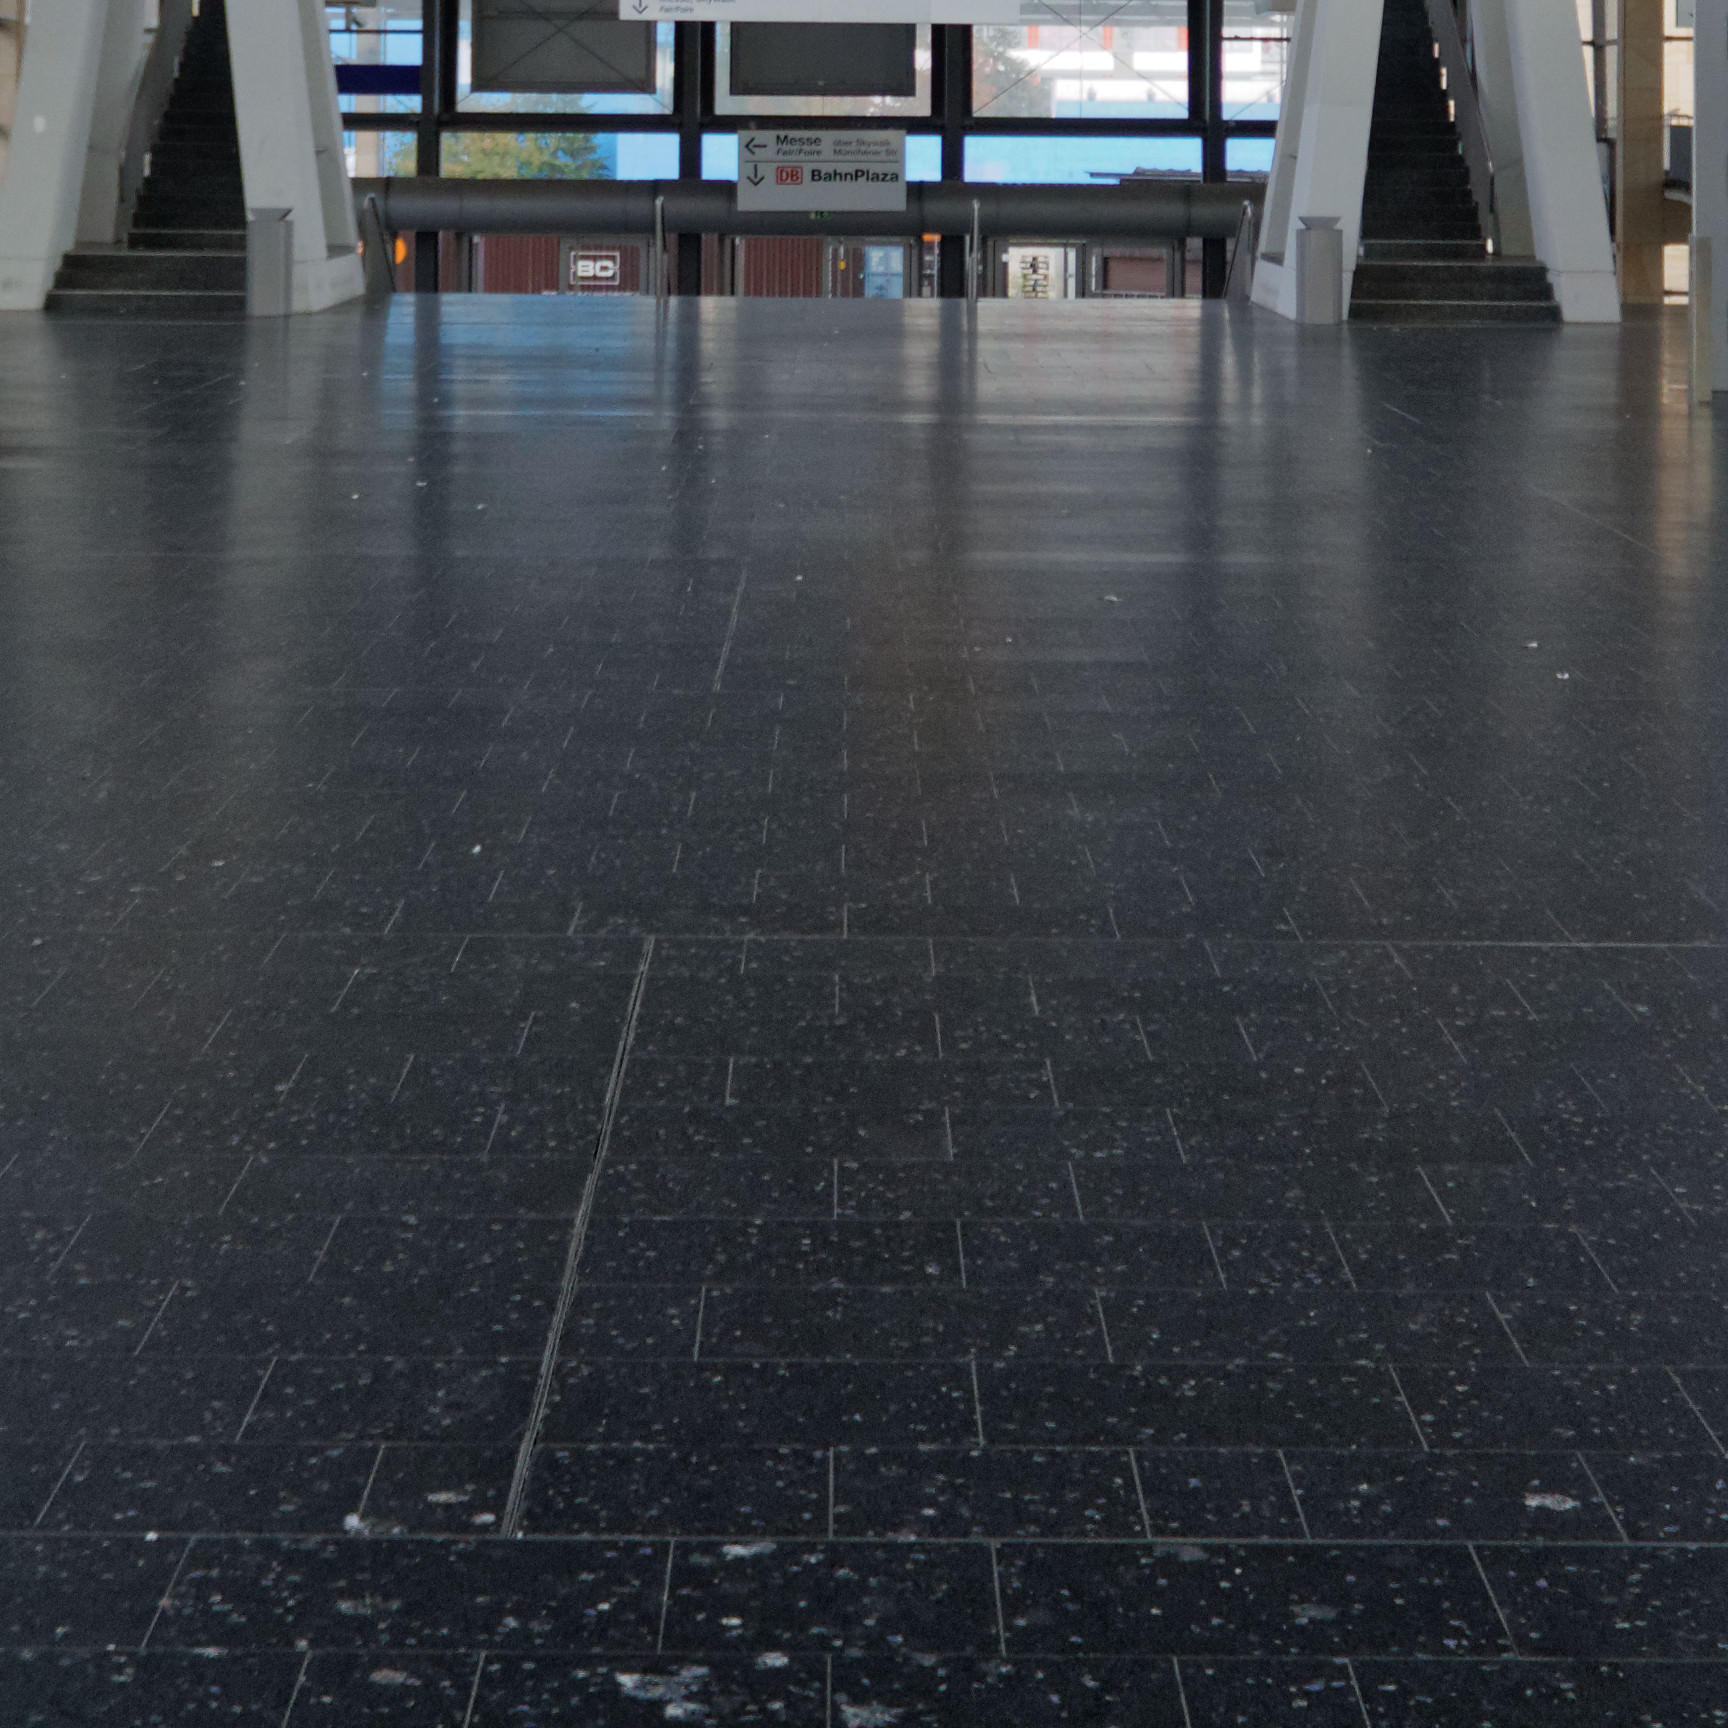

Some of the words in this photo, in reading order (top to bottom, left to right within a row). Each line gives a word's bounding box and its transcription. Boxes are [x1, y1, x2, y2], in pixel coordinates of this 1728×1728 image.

[775, 134, 822, 147] Messe
[778, 167, 802, 184] DB
[811, 169, 899, 183] BahnPlaza
